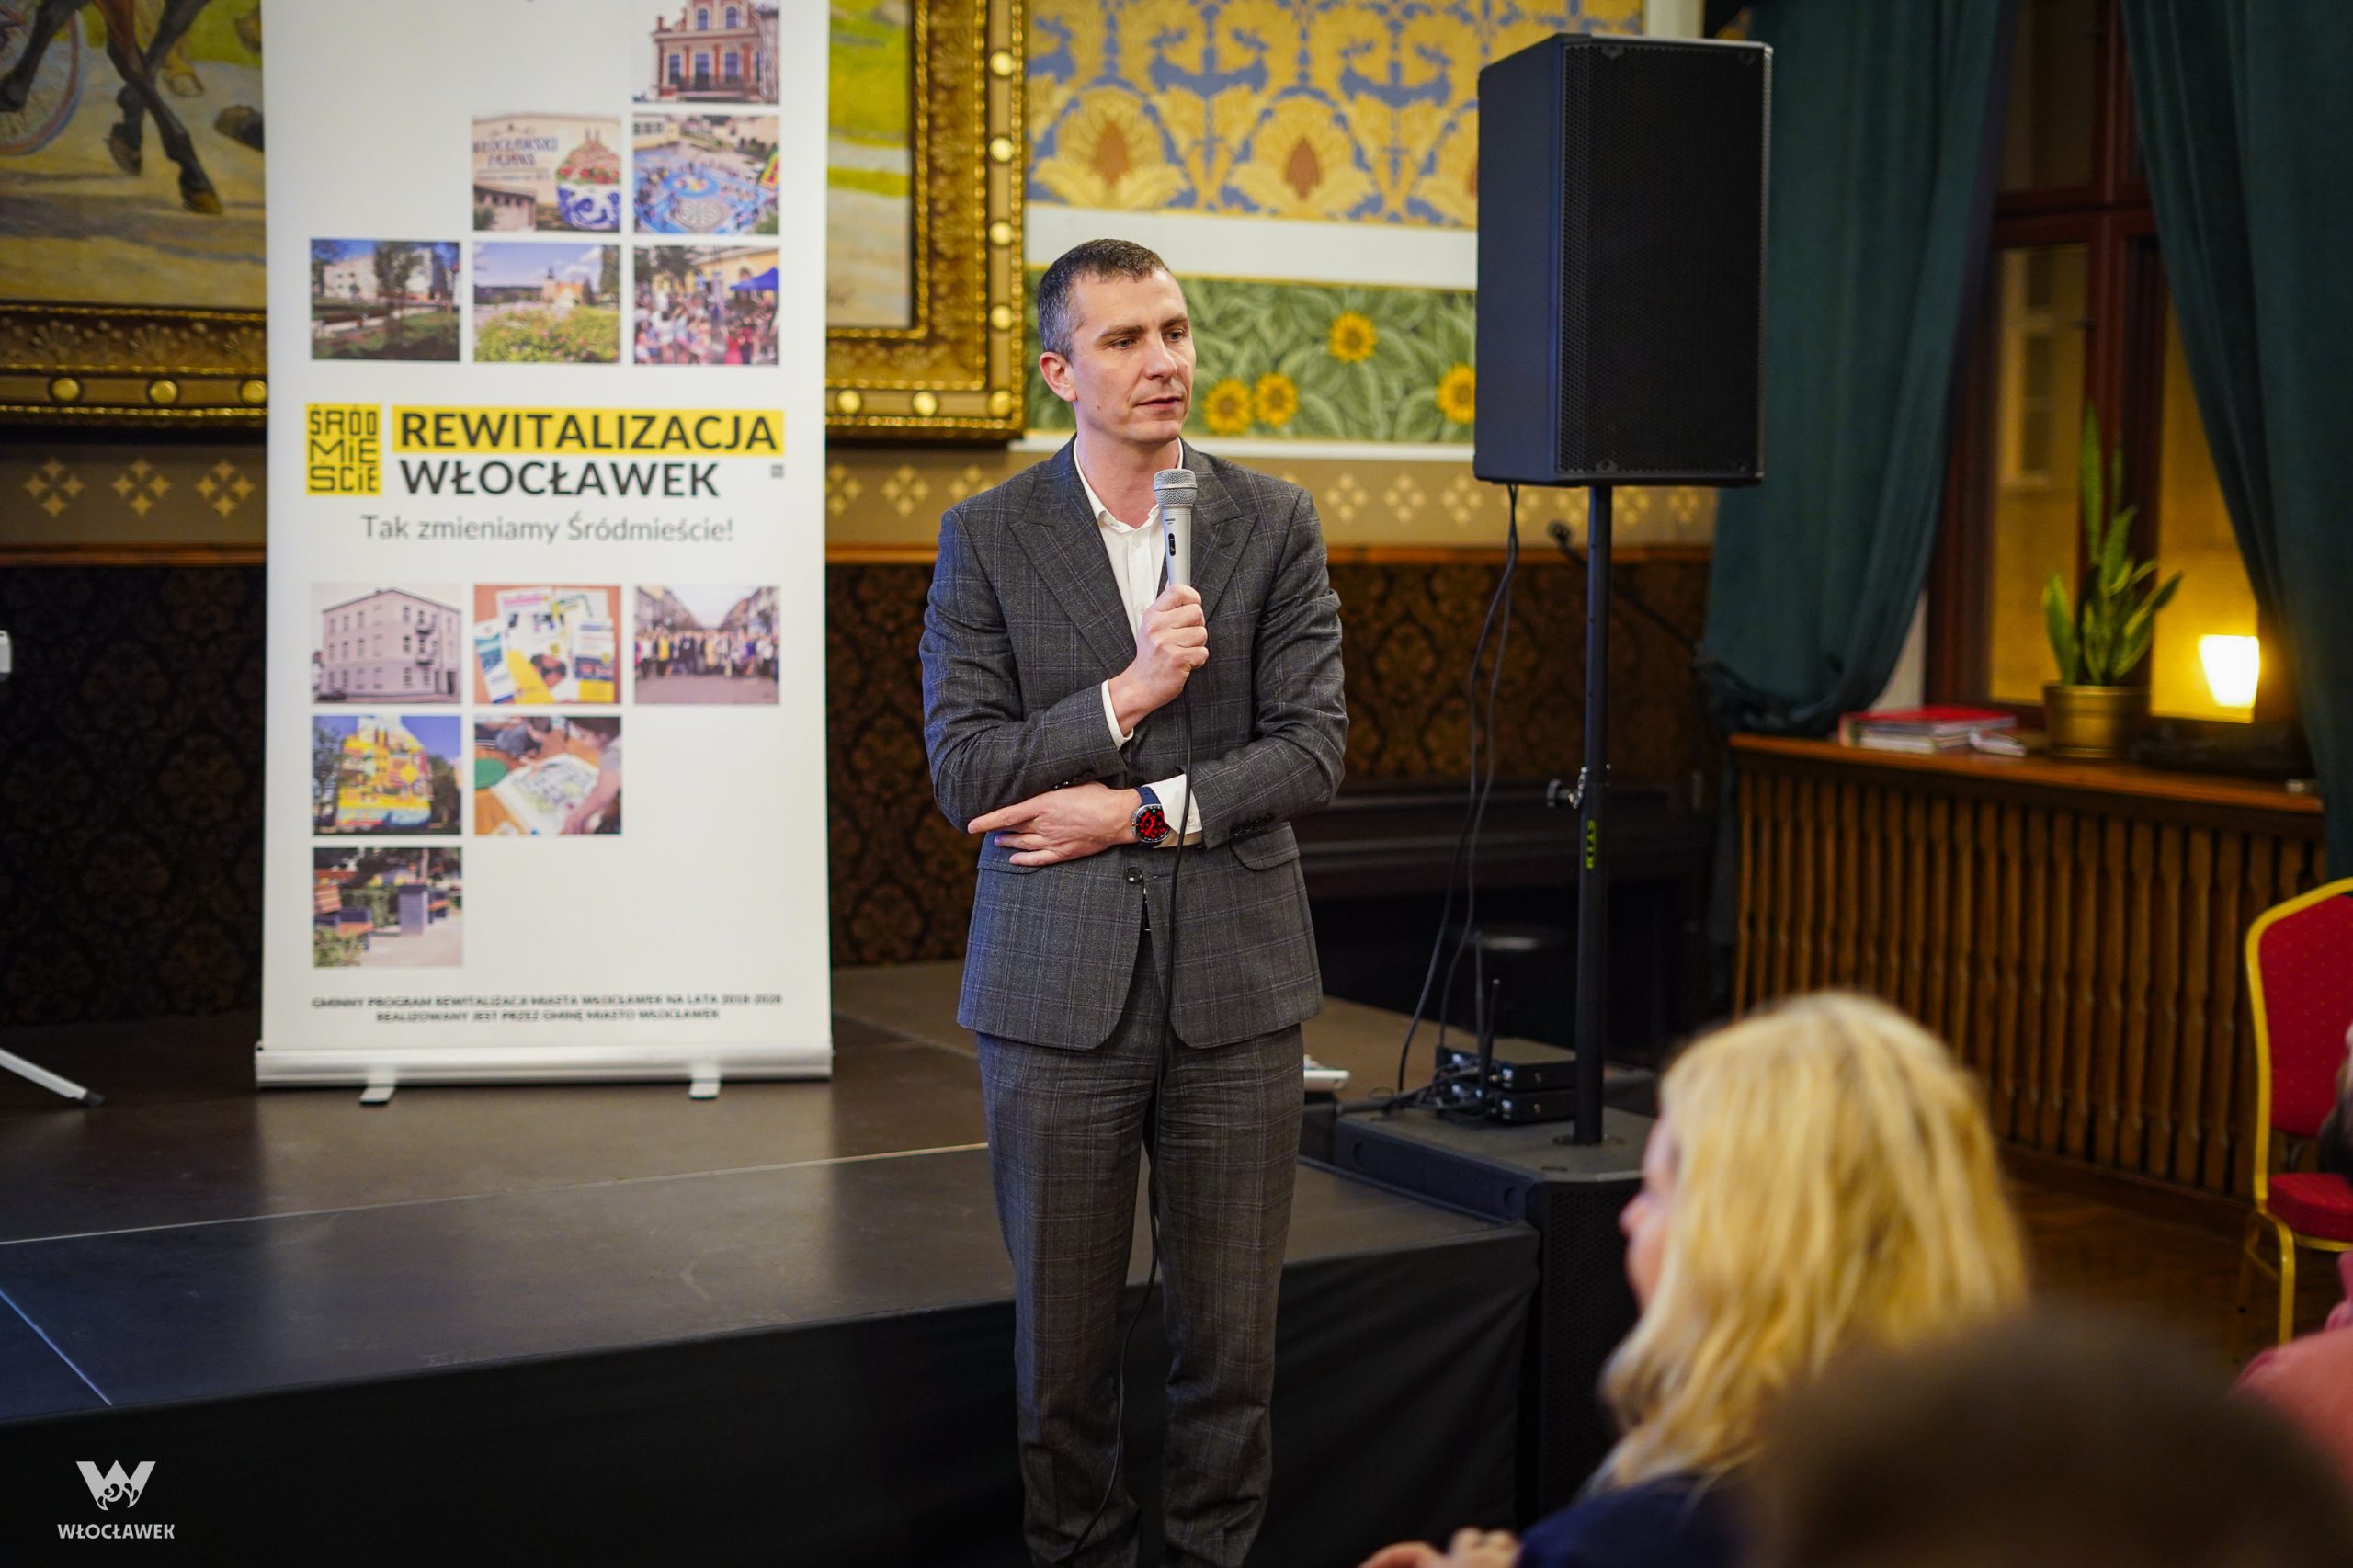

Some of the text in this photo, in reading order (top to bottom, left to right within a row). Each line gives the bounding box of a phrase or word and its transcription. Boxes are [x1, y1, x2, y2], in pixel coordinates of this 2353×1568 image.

[401, 412, 777, 450] REWITALIZACJA
[399, 460, 719, 497] WŁOCŁAWEK
[361, 511, 733, 544] Tak zmieniamy Śródmieście!
